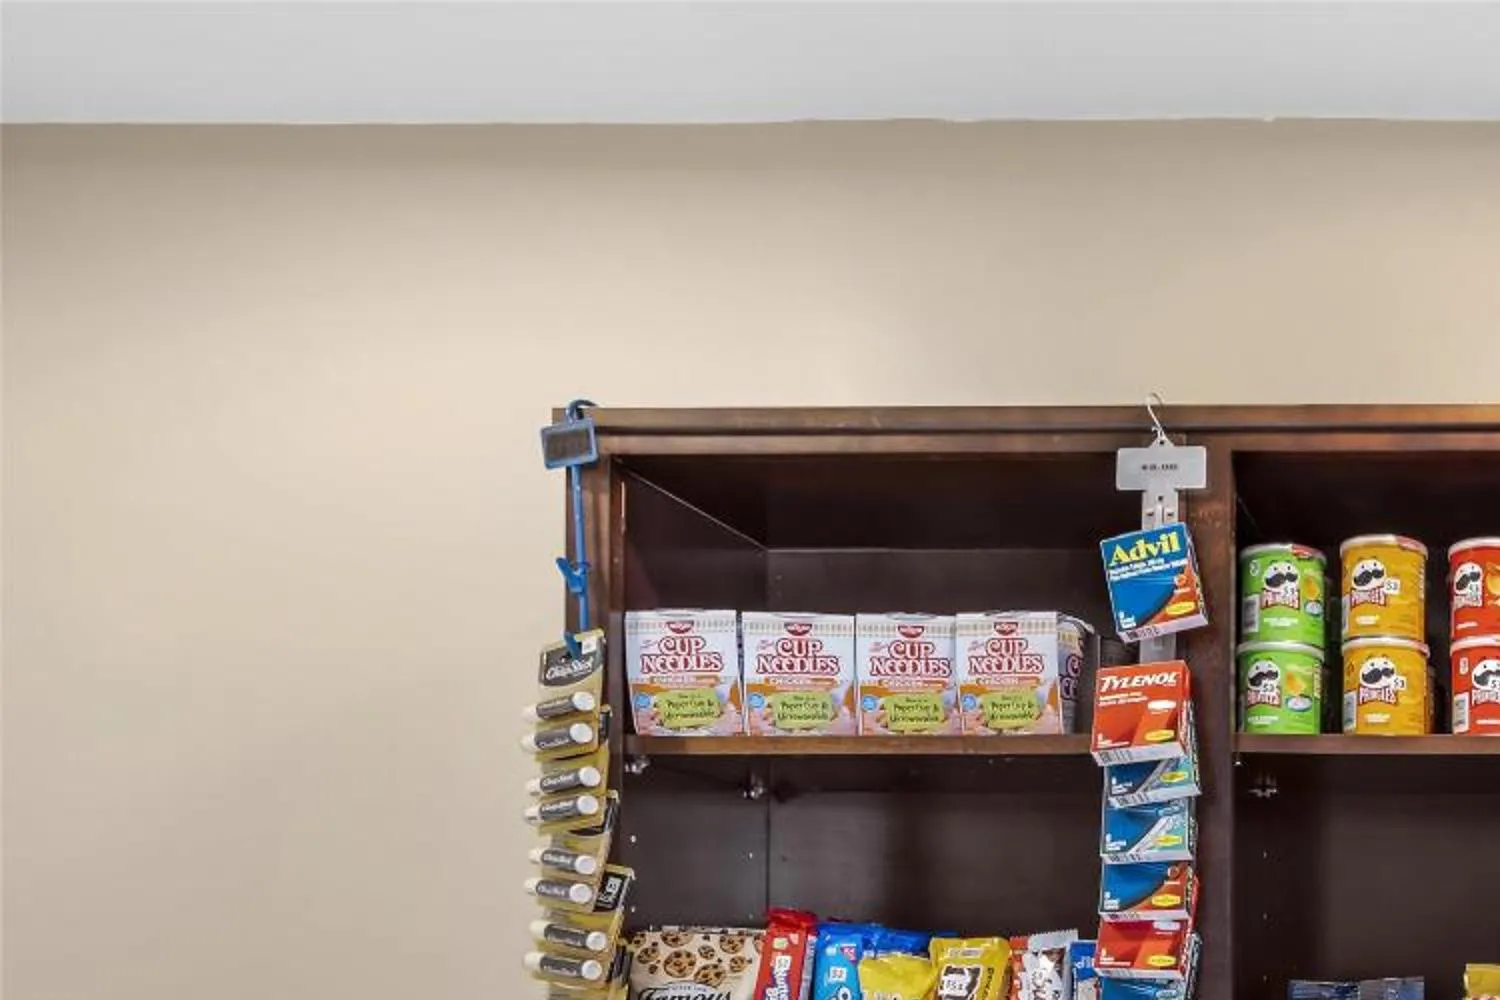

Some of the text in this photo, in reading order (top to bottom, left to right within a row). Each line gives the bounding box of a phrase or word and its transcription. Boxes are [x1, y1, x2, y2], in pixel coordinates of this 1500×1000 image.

[1110, 532, 1181, 567] Advil
[658, 635, 706, 655] CUP
[776, 638, 822, 656] CUP
[889, 640, 935, 658] CUP
[986, 638, 1026, 656] CUP
[640, 652, 723, 674] NOODLES
[757, 656, 840, 674] NOODLES
[870, 657, 952, 677] NOODLES
[968, 655, 1044, 674] NOODLES
[1099, 672, 1179, 693] TYLENOL
